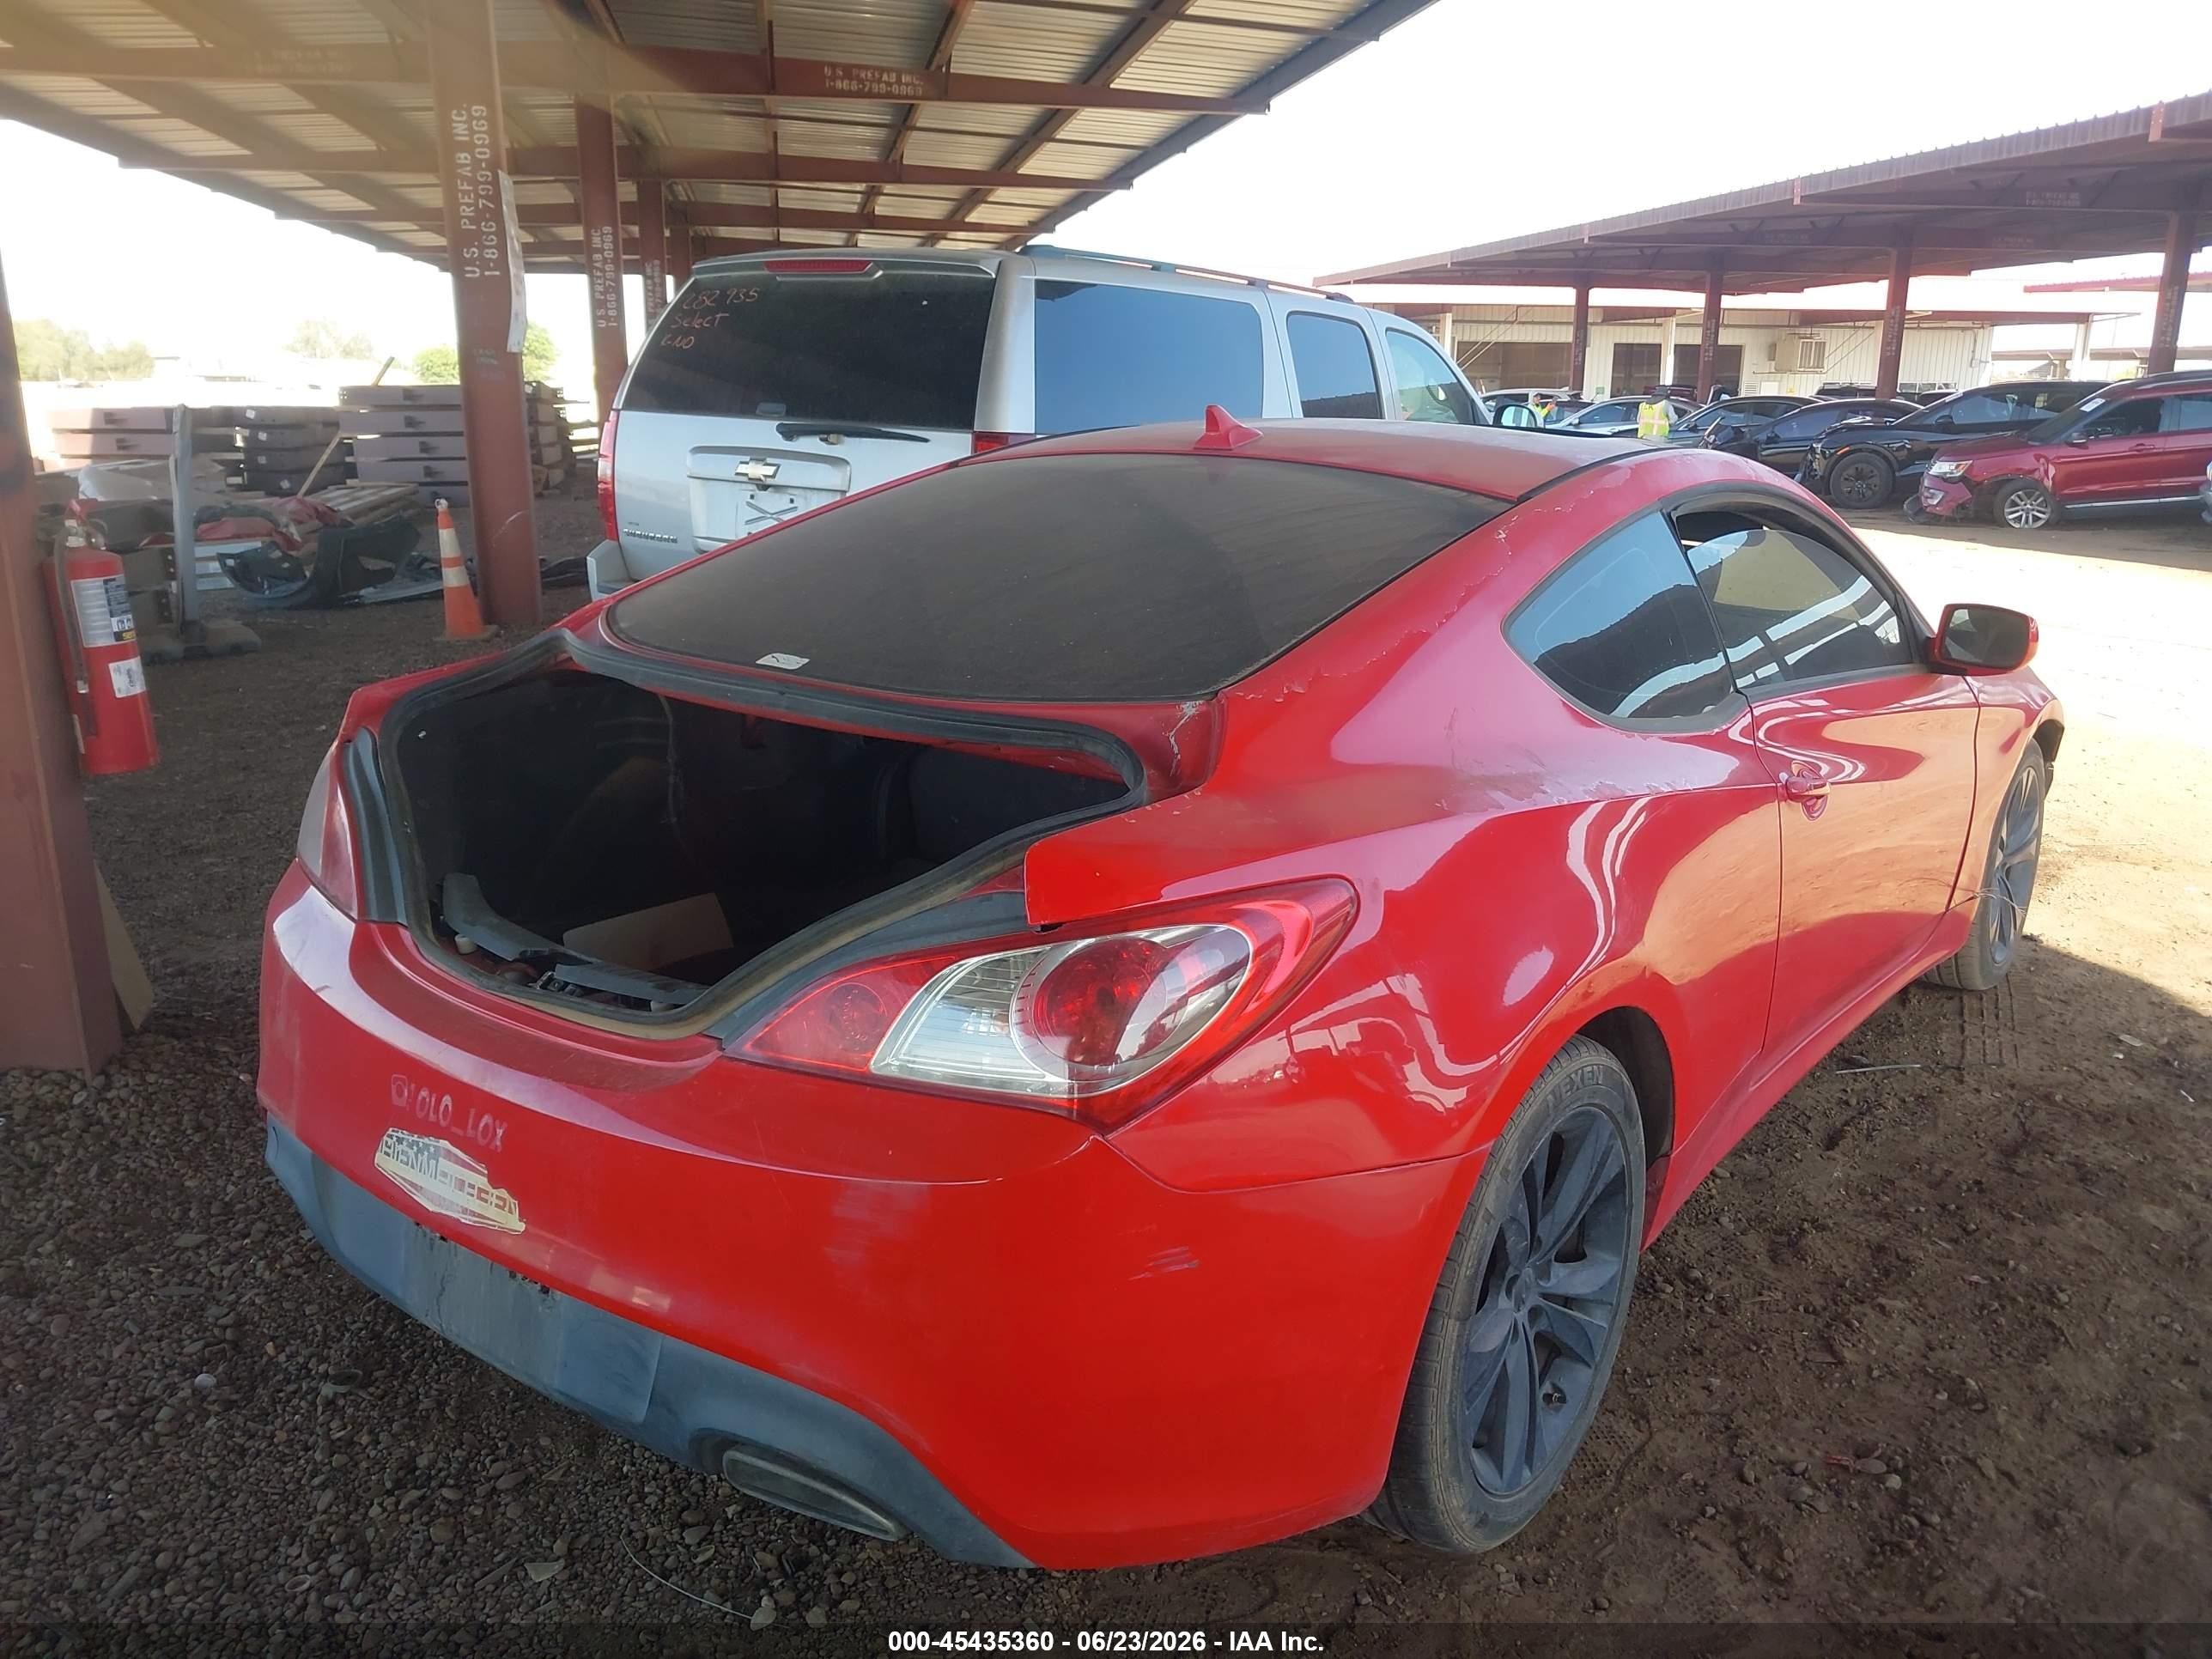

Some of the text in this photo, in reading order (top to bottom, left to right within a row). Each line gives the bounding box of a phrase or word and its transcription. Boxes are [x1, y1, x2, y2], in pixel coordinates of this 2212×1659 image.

[452, 104, 480, 277] U.S. PREFAB INC.
[471, 105, 501, 276] 1-866-799-0969
[592, 253, 605, 299] PREFAB
